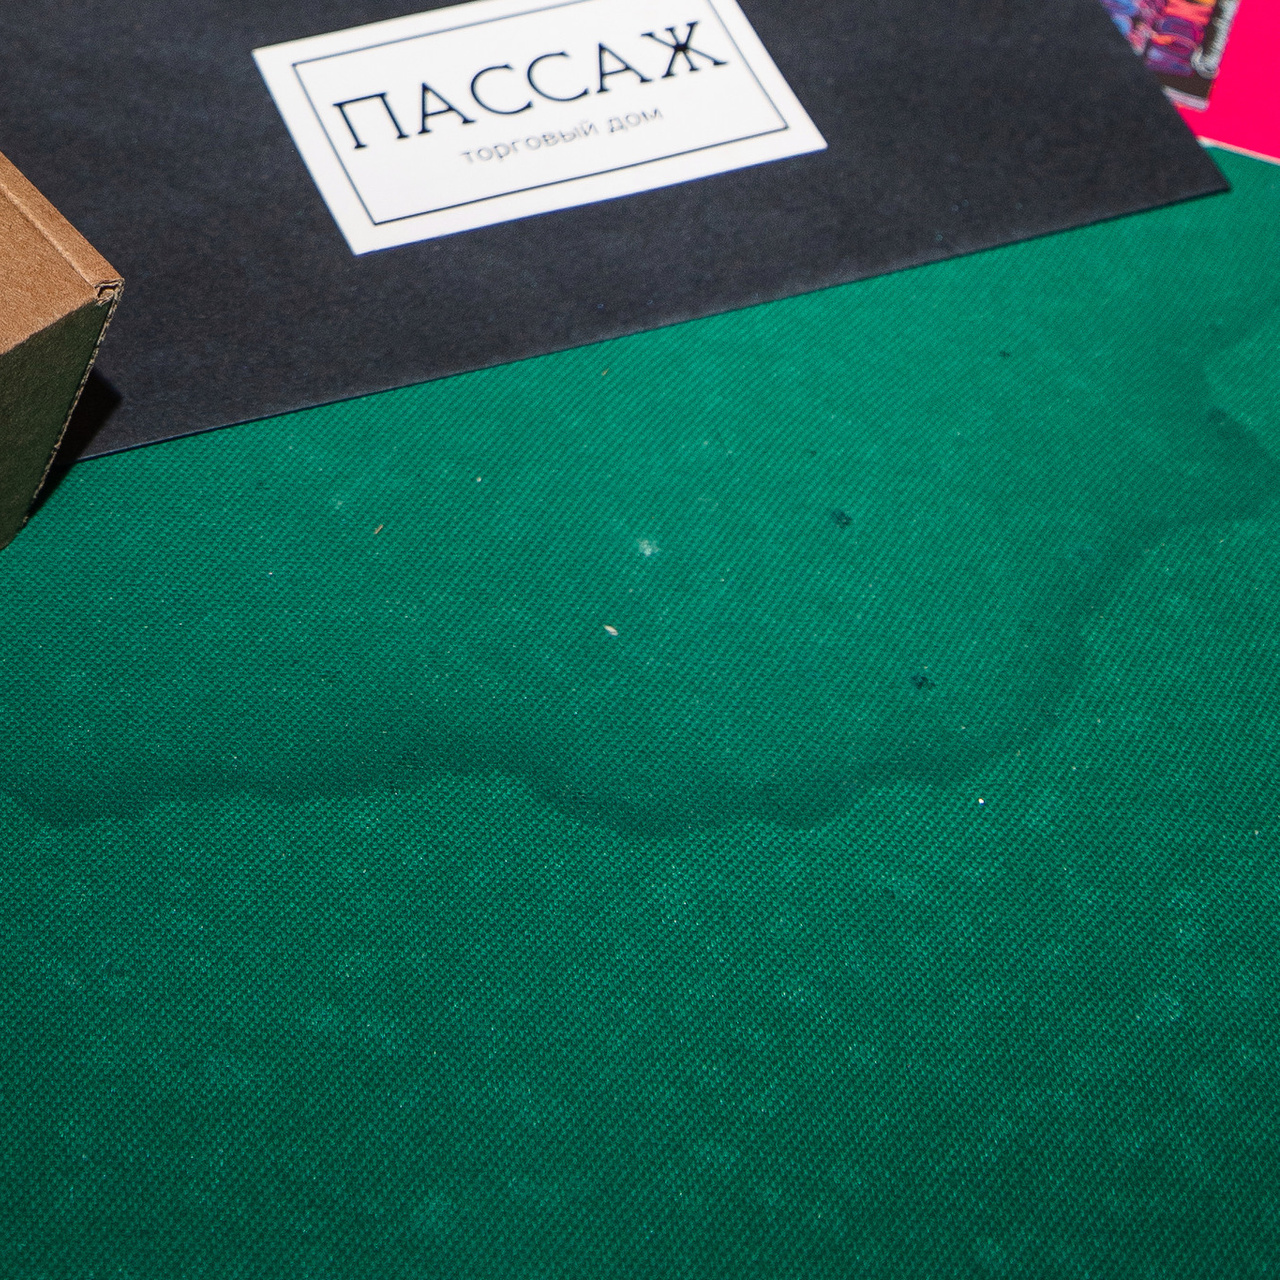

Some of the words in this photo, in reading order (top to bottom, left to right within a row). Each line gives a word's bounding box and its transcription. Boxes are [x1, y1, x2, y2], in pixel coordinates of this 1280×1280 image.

[332, 20, 728, 150] ПАССАЖ
[458, 118, 599, 164] торговый
[607, 107, 664, 135] дом
